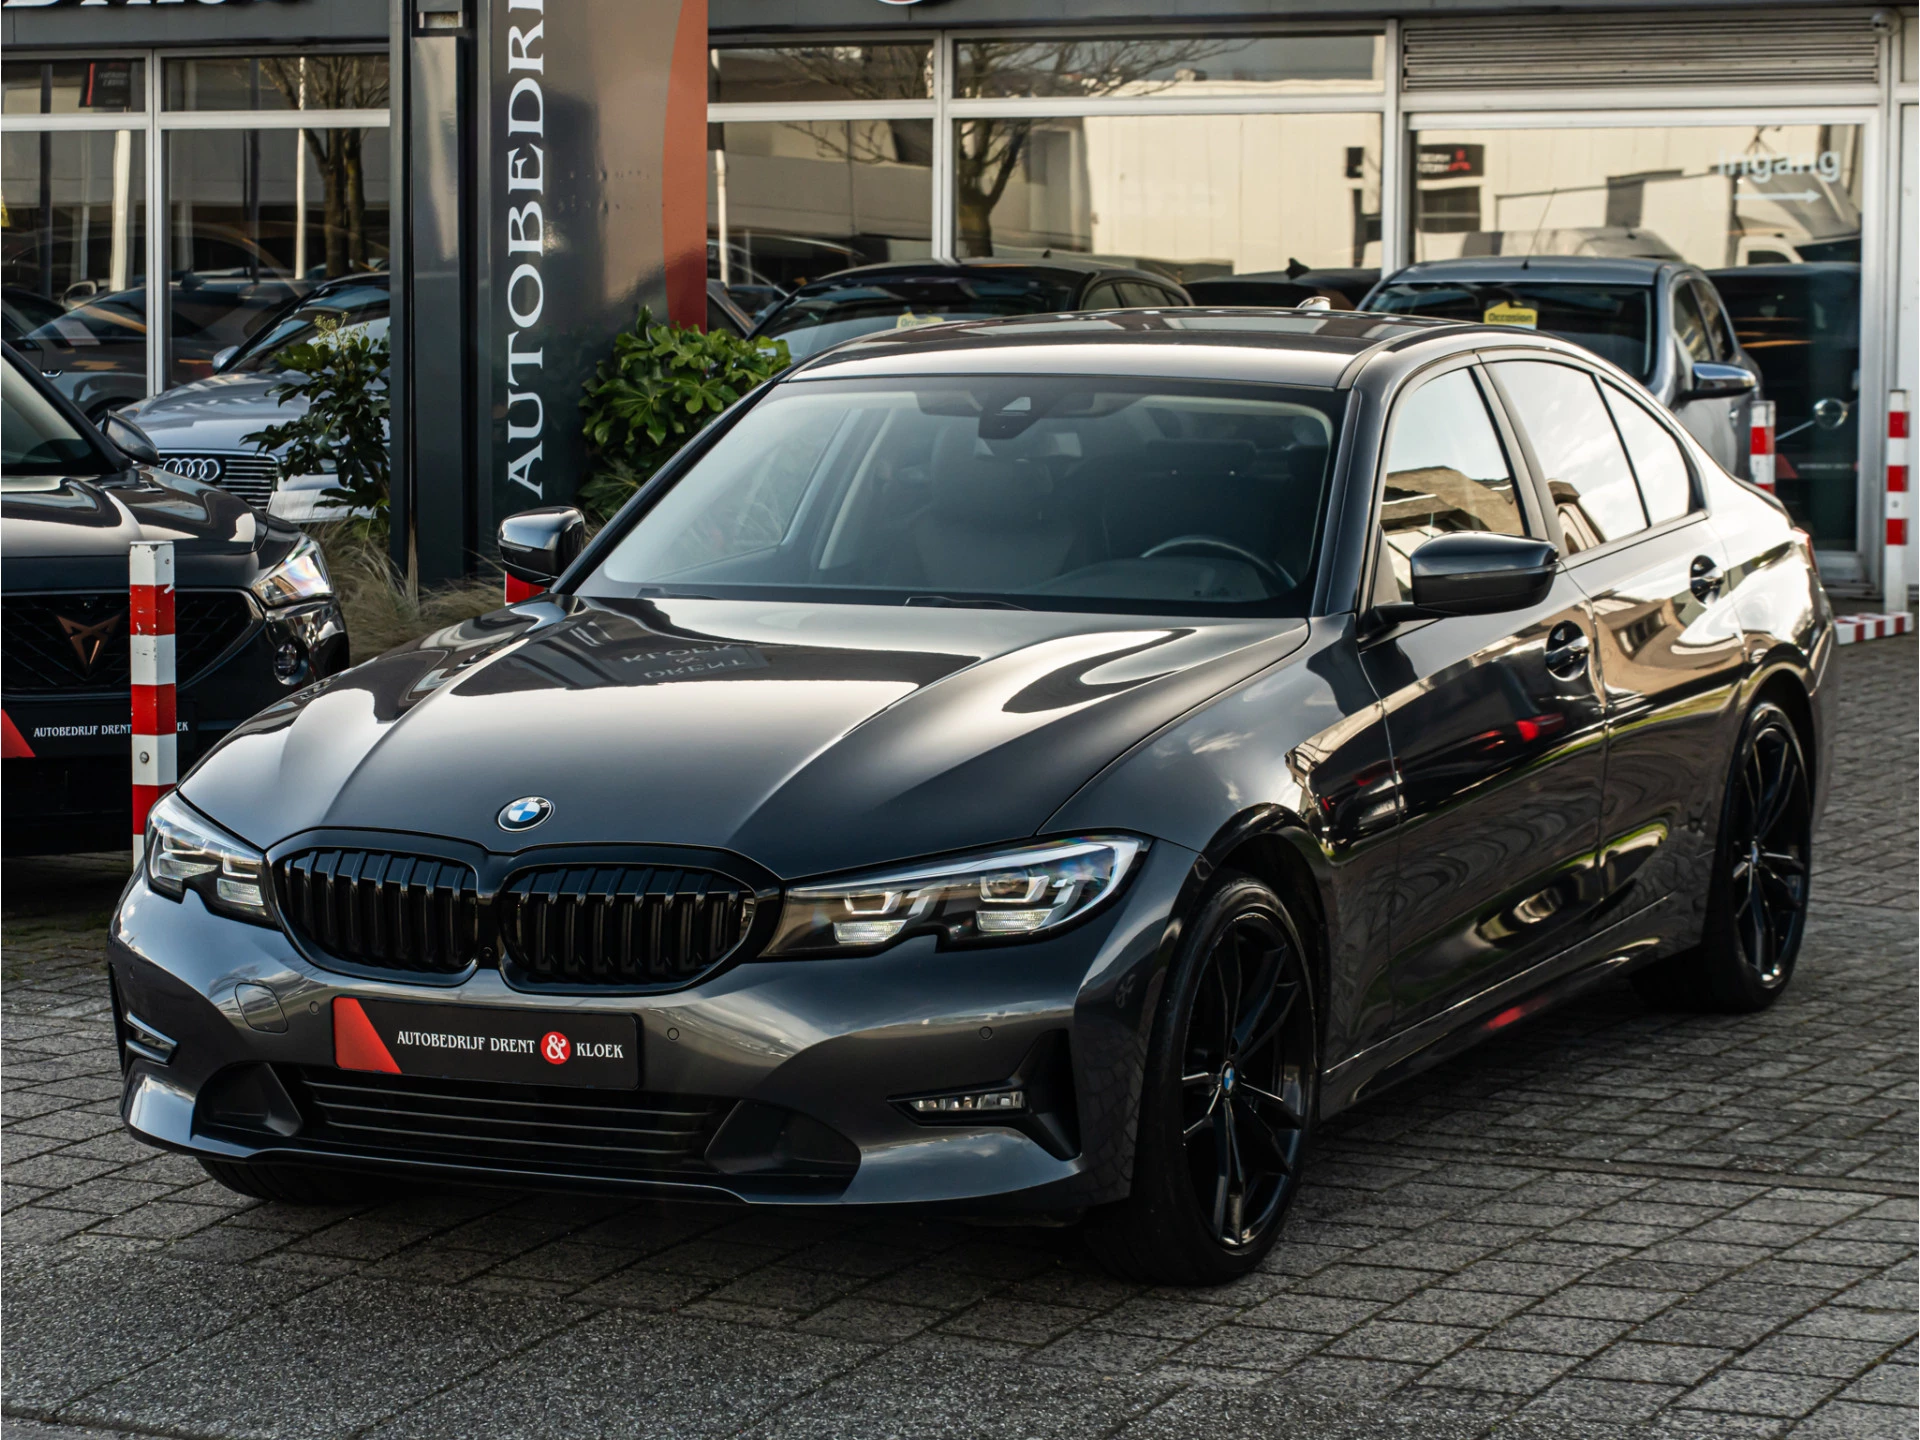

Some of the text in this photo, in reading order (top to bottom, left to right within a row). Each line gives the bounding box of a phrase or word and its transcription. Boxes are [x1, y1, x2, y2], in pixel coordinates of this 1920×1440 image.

[33, 724, 132, 738] AUTOBEDRIJF DRENT
[397, 1030, 624, 1060] AUTOBEDRIJF DRENT & KLOEK
